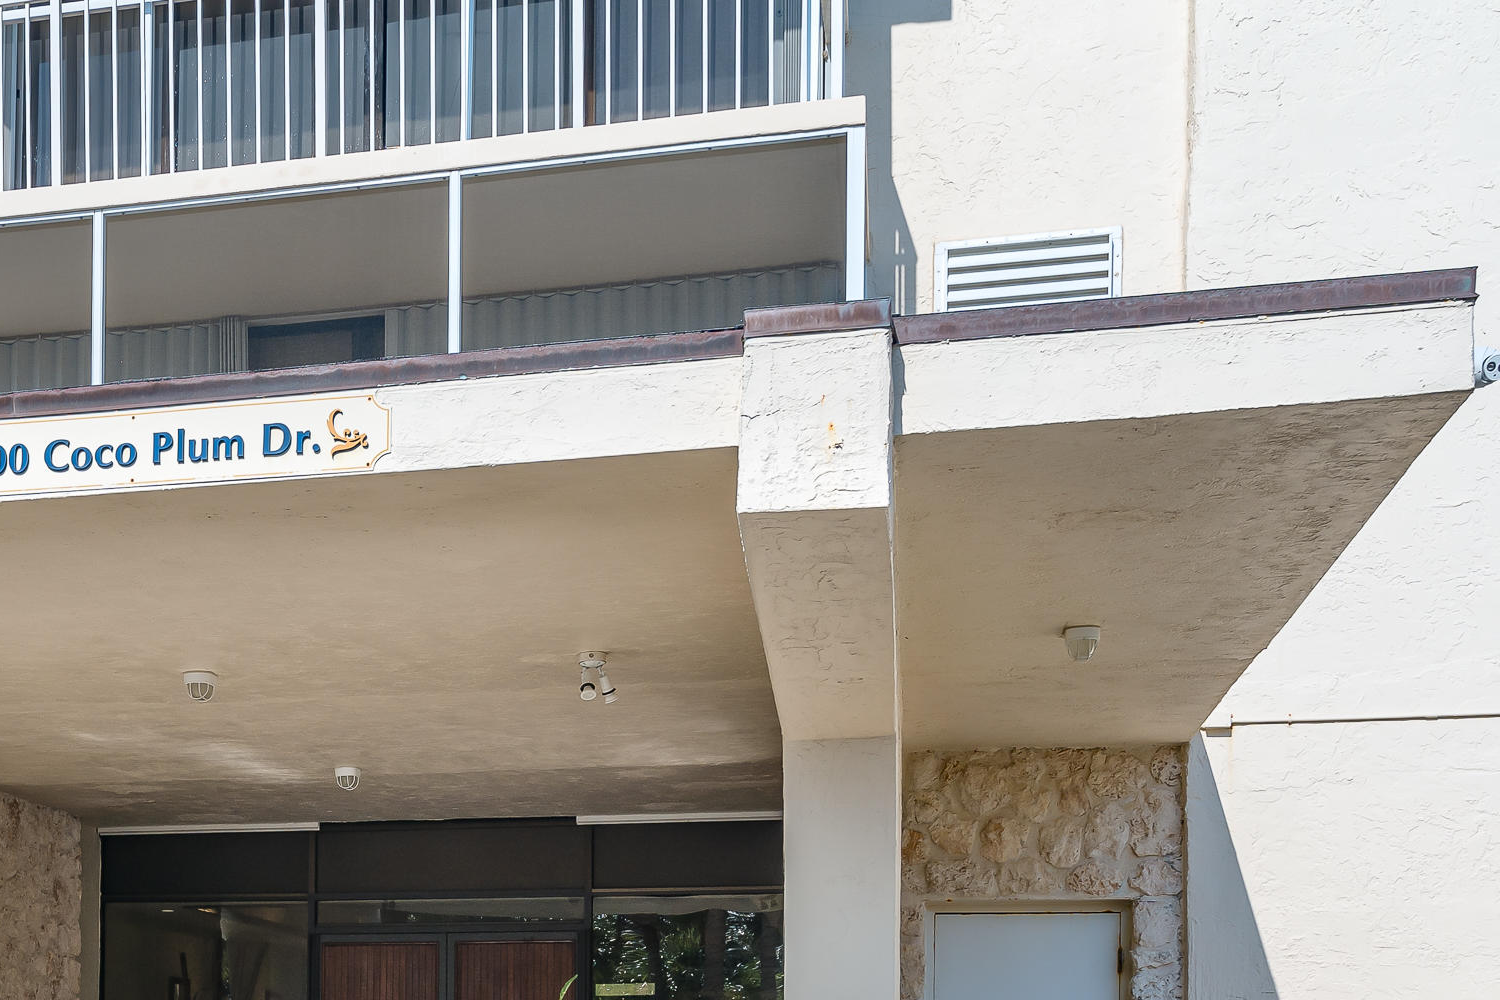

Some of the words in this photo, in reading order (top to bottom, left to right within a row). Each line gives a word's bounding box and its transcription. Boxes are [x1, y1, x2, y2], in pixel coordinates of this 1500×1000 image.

[43, 438, 138, 473] Coco
[152, 428, 246, 466] Plum
[261, 422, 322, 458] Dr.
